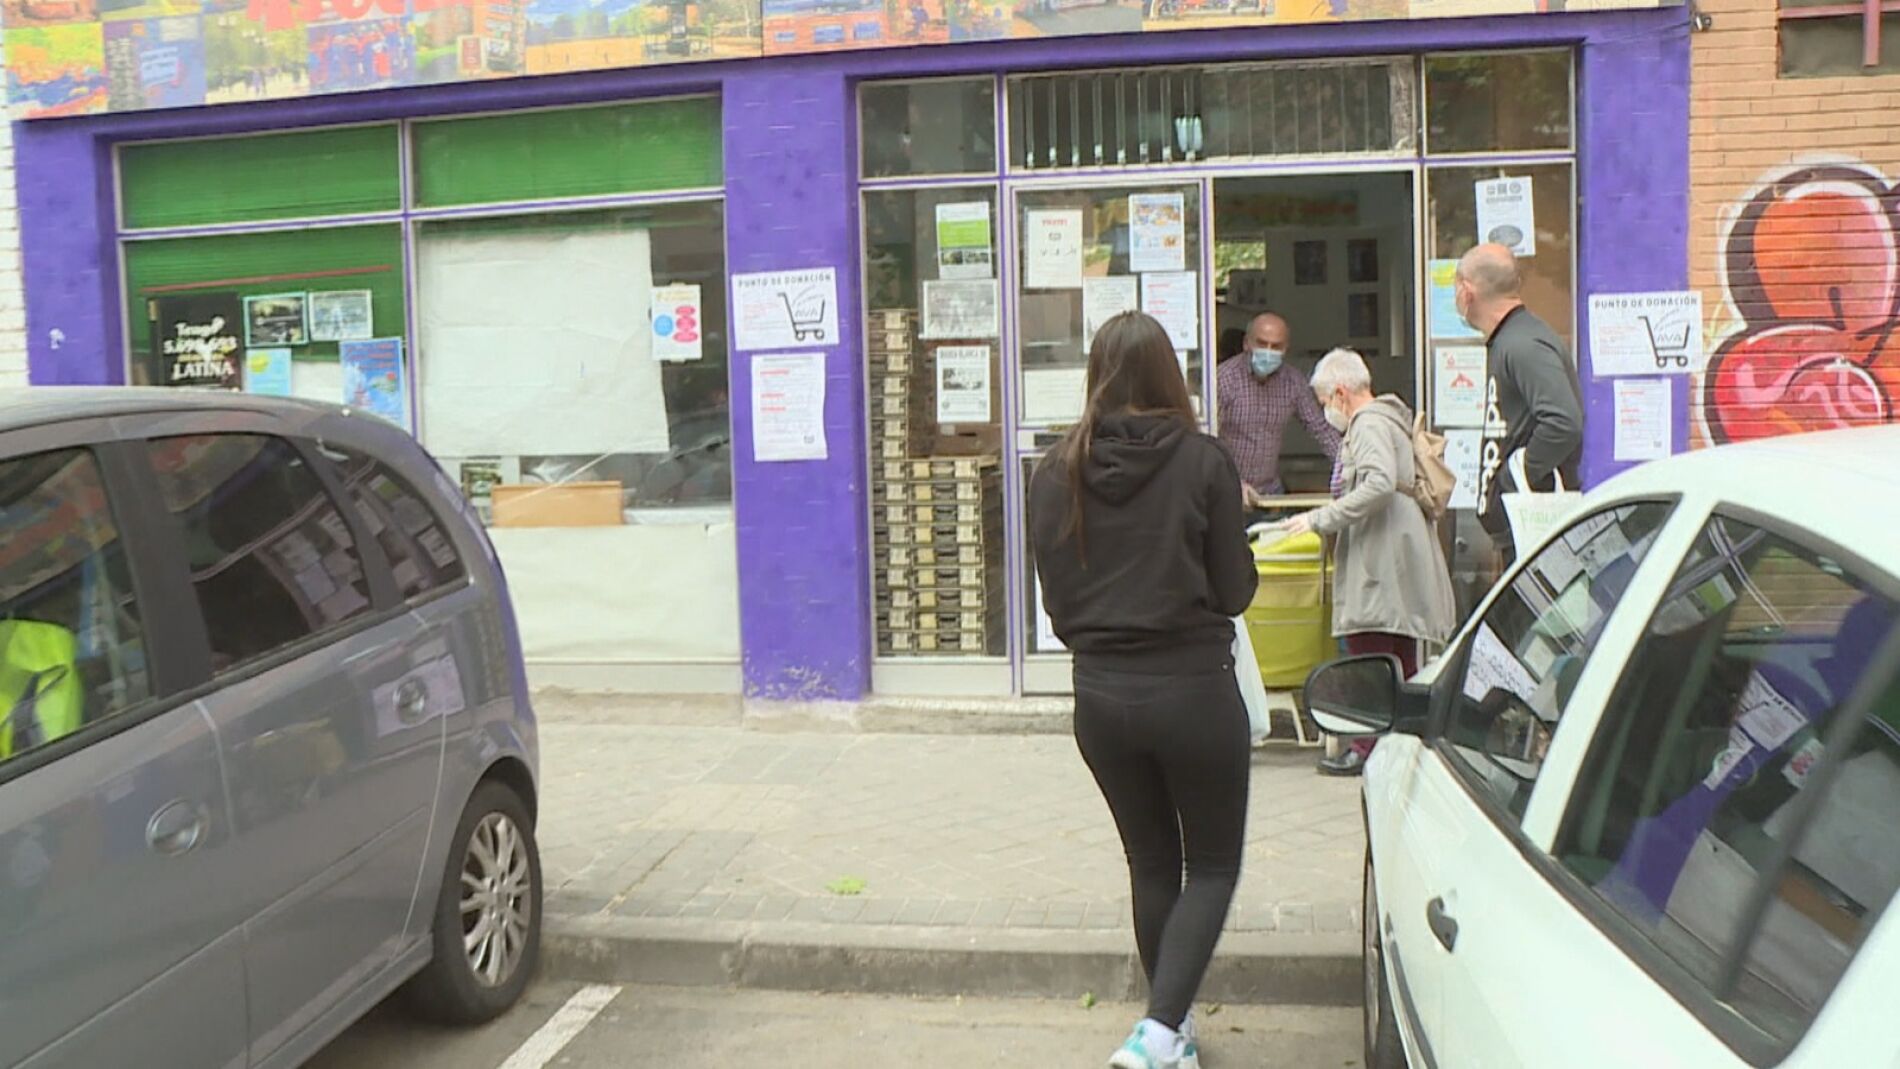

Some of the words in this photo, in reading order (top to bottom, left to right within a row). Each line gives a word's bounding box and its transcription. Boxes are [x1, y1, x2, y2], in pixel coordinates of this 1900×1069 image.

[738, 278, 768, 287] PUNTO
[1594, 299, 1628, 309] PUNTO
[1630, 299, 1644, 308] DE
[1646, 296, 1698, 307] DONACIÓN
[171, 361, 235, 380] LATINA
